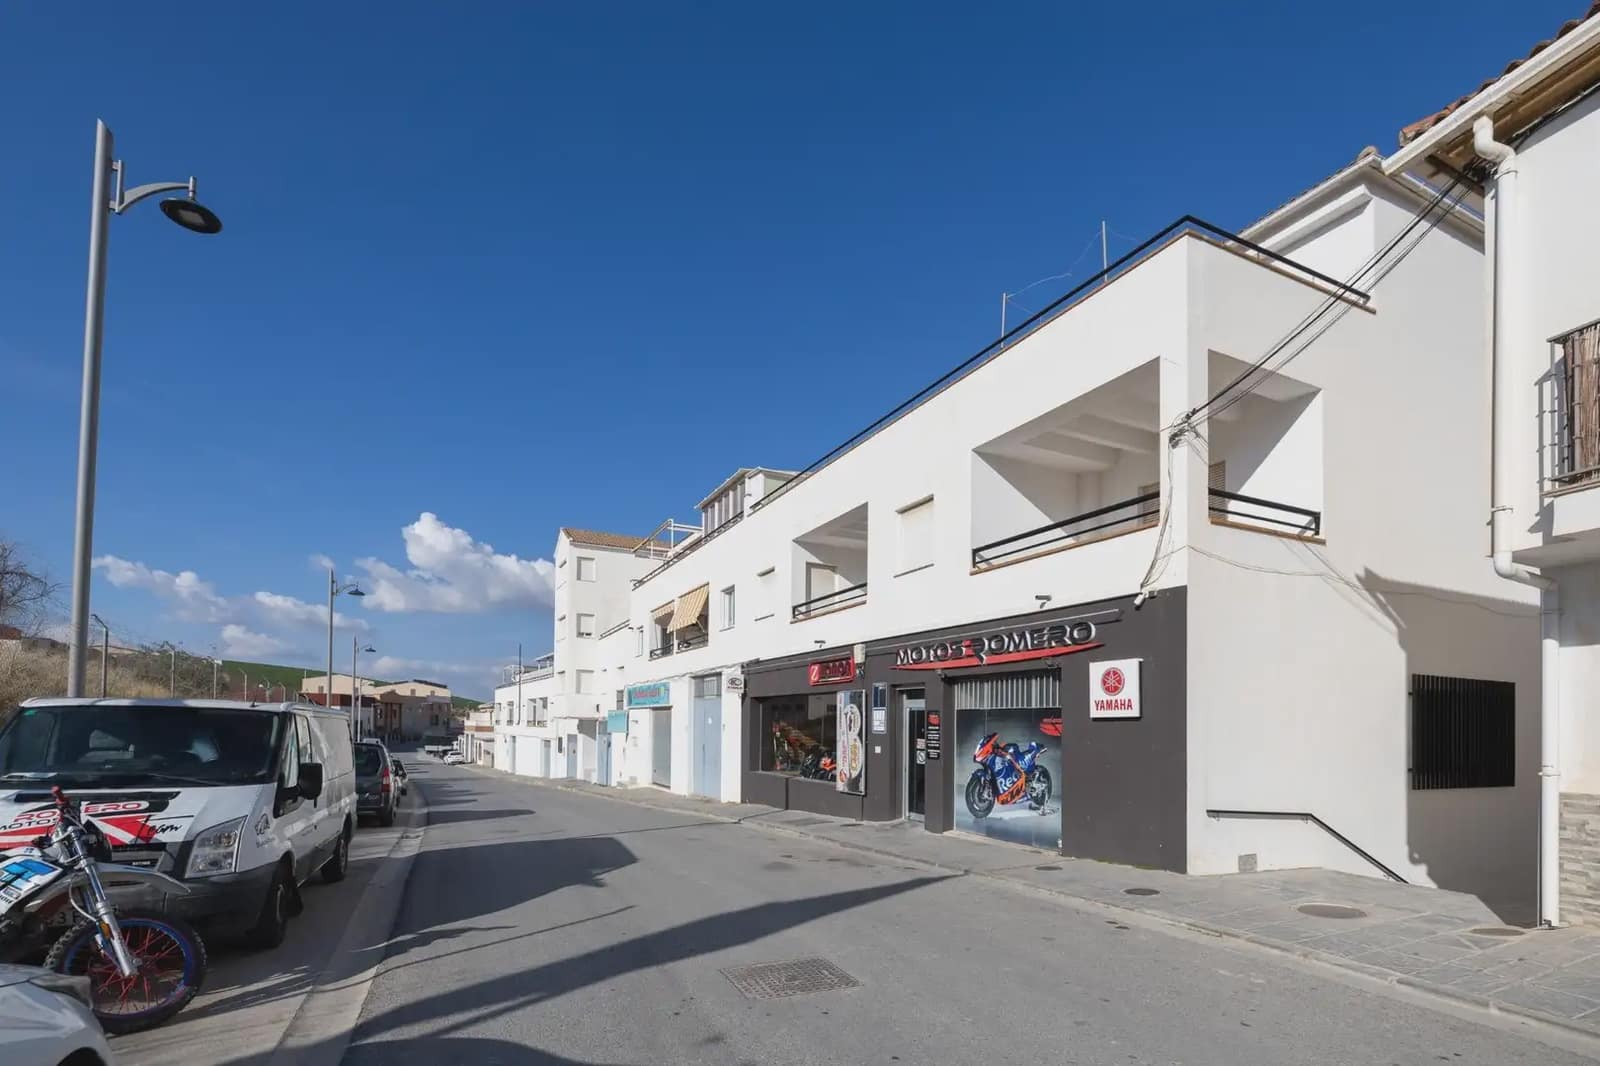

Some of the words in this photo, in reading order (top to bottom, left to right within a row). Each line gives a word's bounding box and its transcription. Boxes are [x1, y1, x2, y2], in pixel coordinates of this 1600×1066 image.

[896, 638, 967, 665] MOTOS
[970, 621, 1095, 665] ROMERO
[1094, 698, 1133, 711] YAMAHA
[13, 801, 143, 823] ROERO
